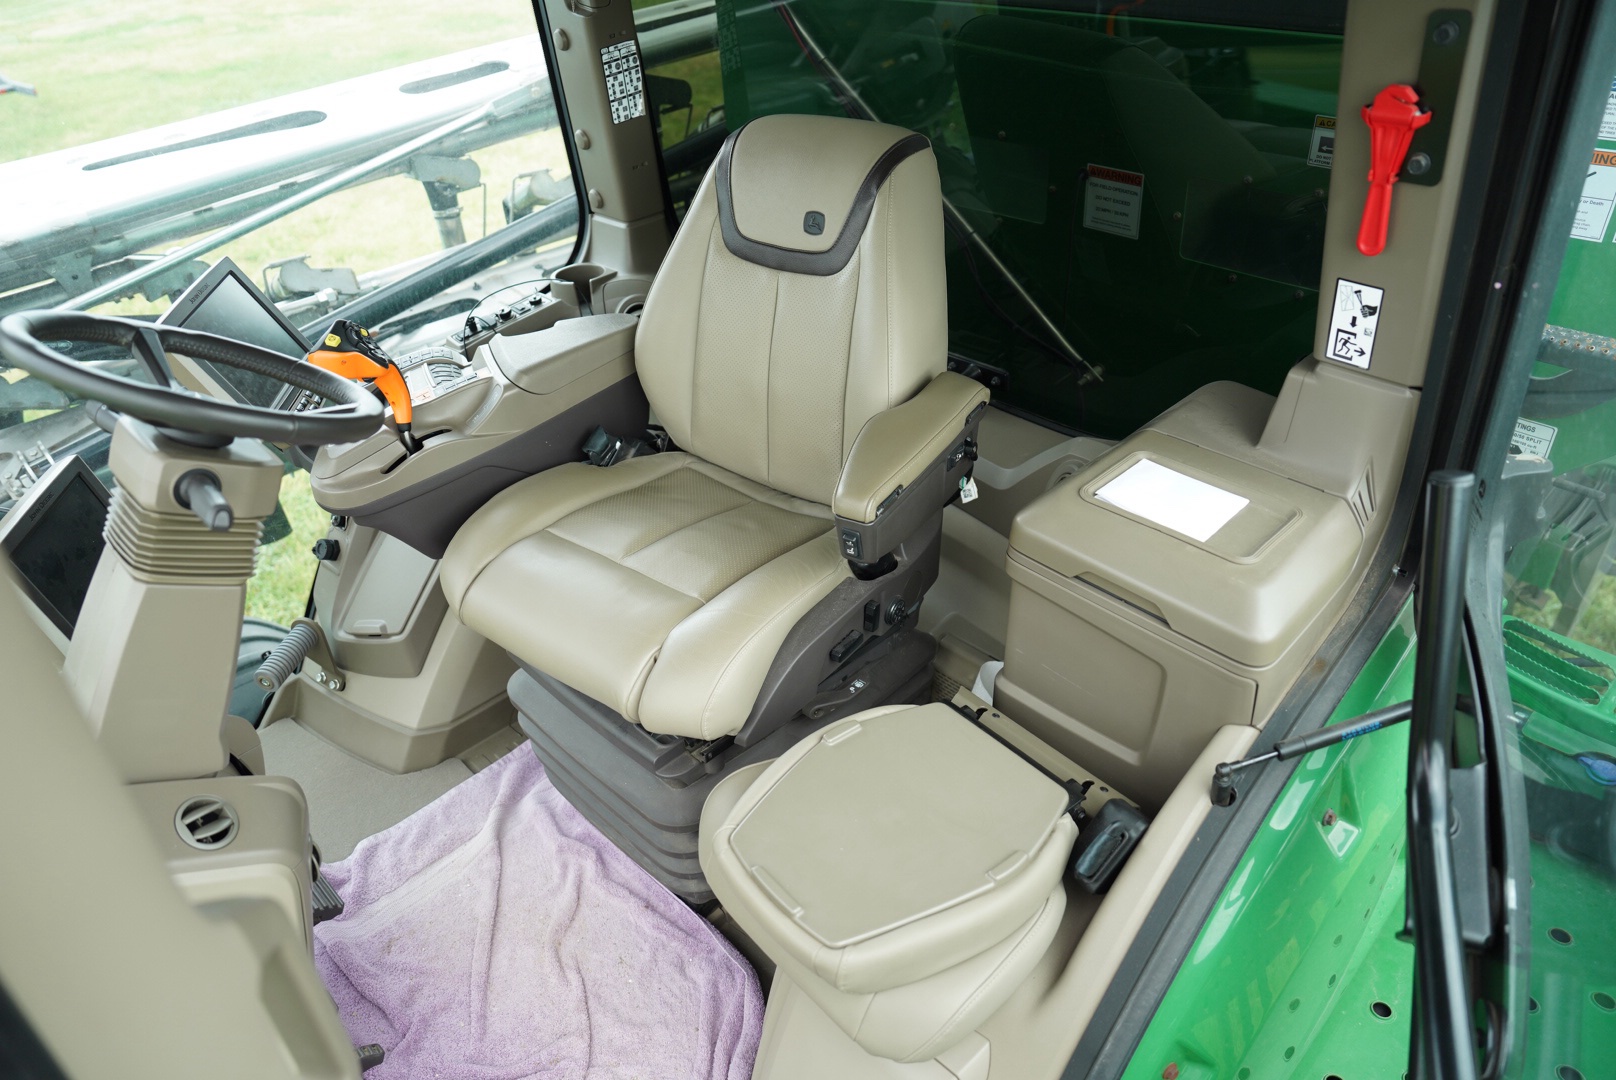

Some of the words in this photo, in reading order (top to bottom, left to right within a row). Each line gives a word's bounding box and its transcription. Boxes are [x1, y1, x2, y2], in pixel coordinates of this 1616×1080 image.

[1096, 168, 1142, 186] WARNING
[1517, 423, 1536, 433] TINGS
[1526, 436, 1542, 445] SPLIT
